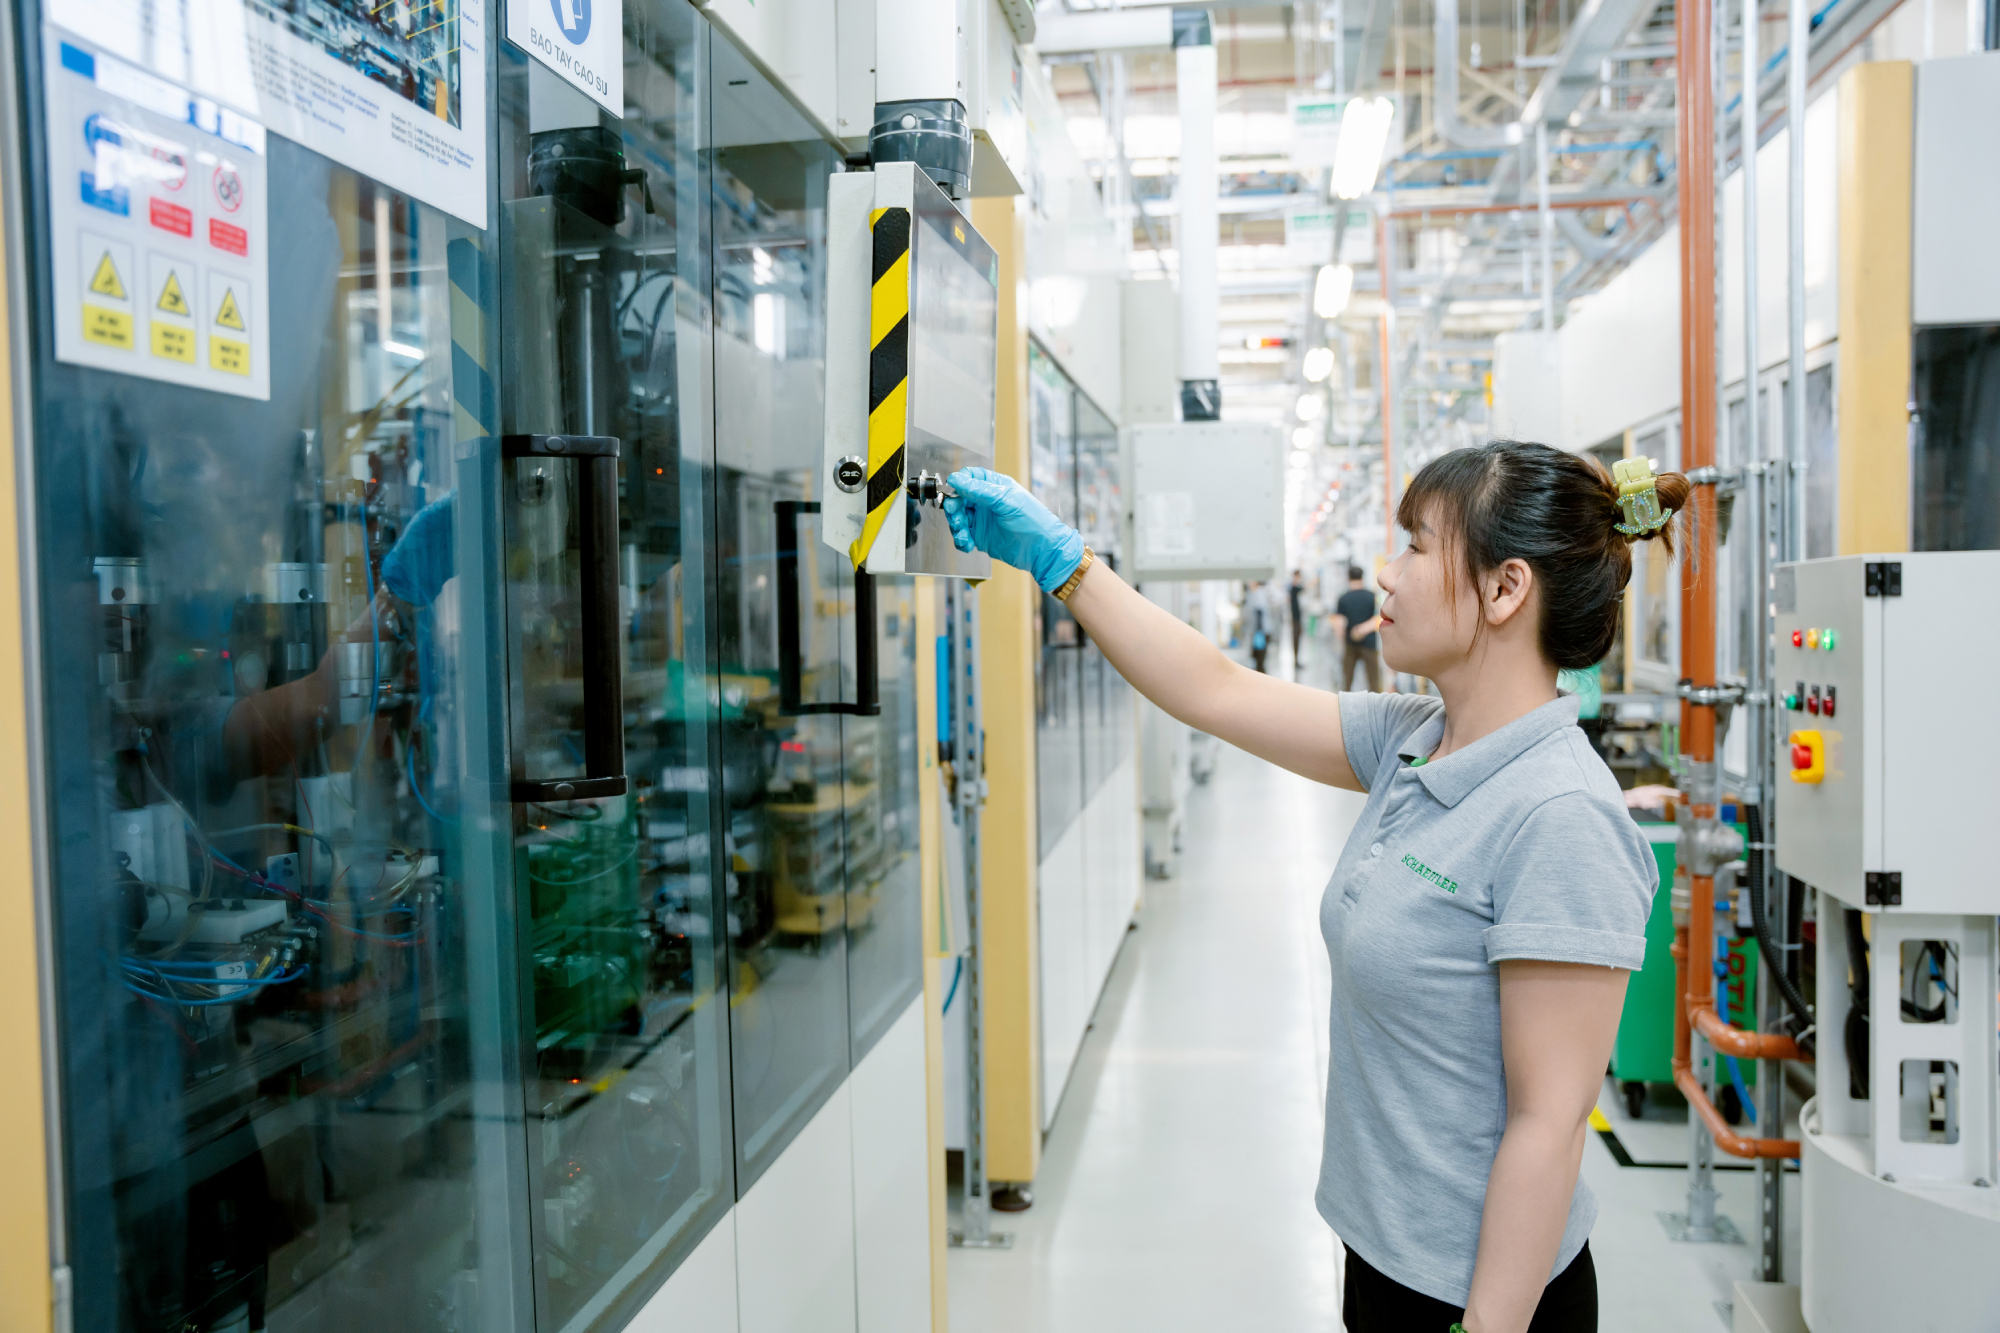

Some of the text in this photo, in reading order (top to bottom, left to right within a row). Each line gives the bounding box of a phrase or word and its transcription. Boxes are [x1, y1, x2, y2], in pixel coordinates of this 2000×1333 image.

[530, 27, 608, 96] BAO TAY CAO SU
[312, 90, 327, 103] Noise
[328, 99, 345, 114] testing
[342, 85, 356, 98] Radial
[357, 95, 379, 111] clearance
[342, 96, 354, 107] Axial
[355, 104, 377, 119] clearance
[312, 112, 345, 134] Noise testing
[391, 112, 406, 125] Station
[457, 148, 474, 162] Rejection
[391, 121, 406, 135] Station
[454, 156, 471, 169] Rejection
[391, 131, 407, 144] Station
[437, 156, 449, 166] Outlet
